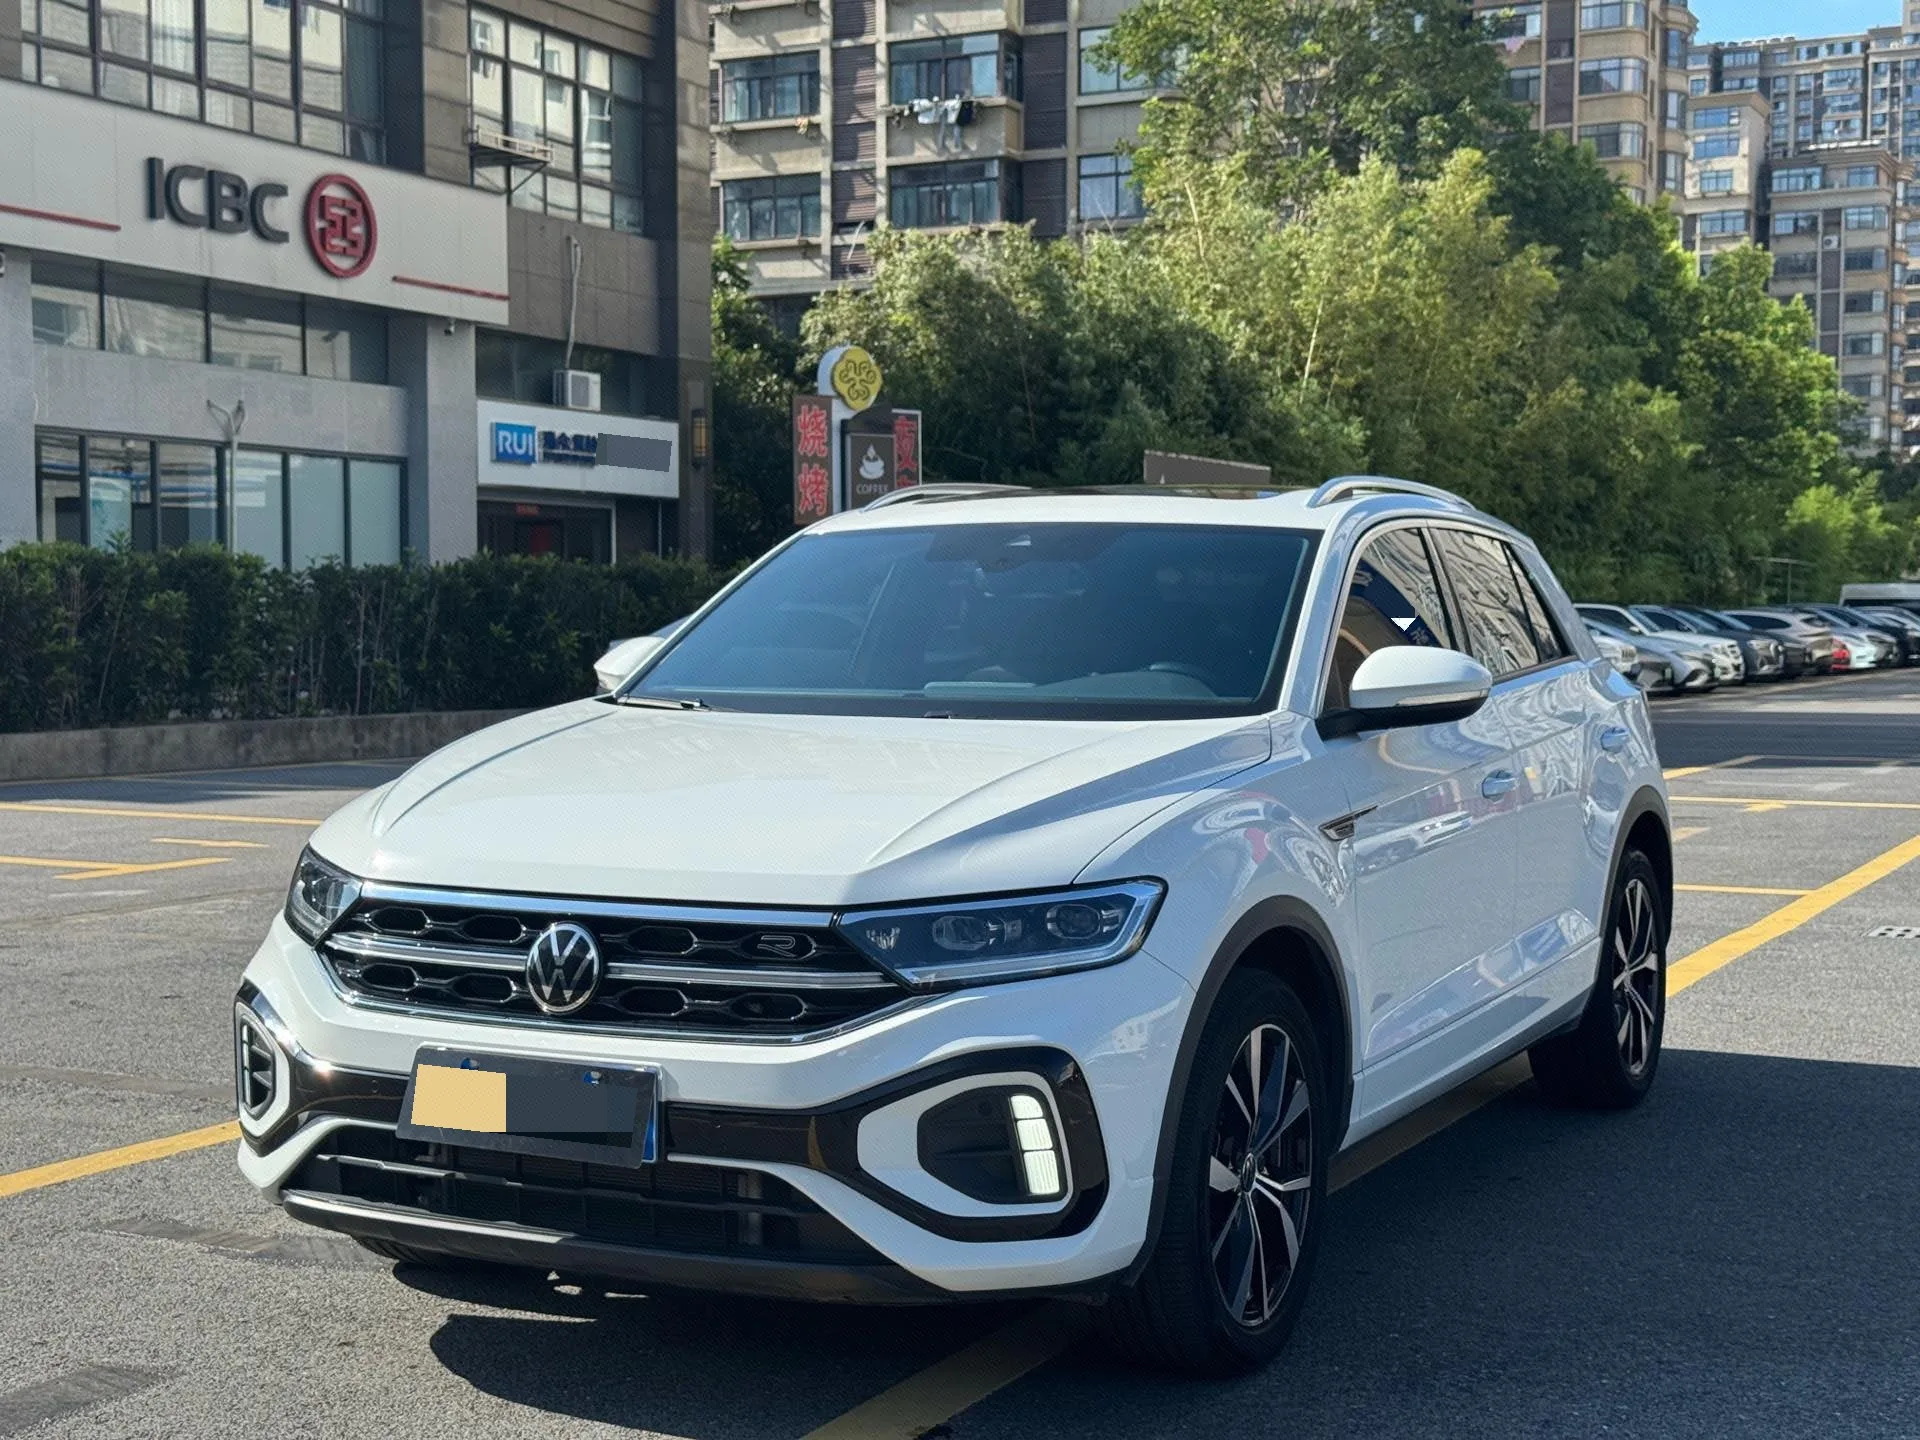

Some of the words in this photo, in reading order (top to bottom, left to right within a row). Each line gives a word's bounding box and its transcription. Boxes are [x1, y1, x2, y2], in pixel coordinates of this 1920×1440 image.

[147, 157, 290, 243] ICBC
[498, 430, 534, 456] RUI
[797, 405, 829, 516] 烧烤
